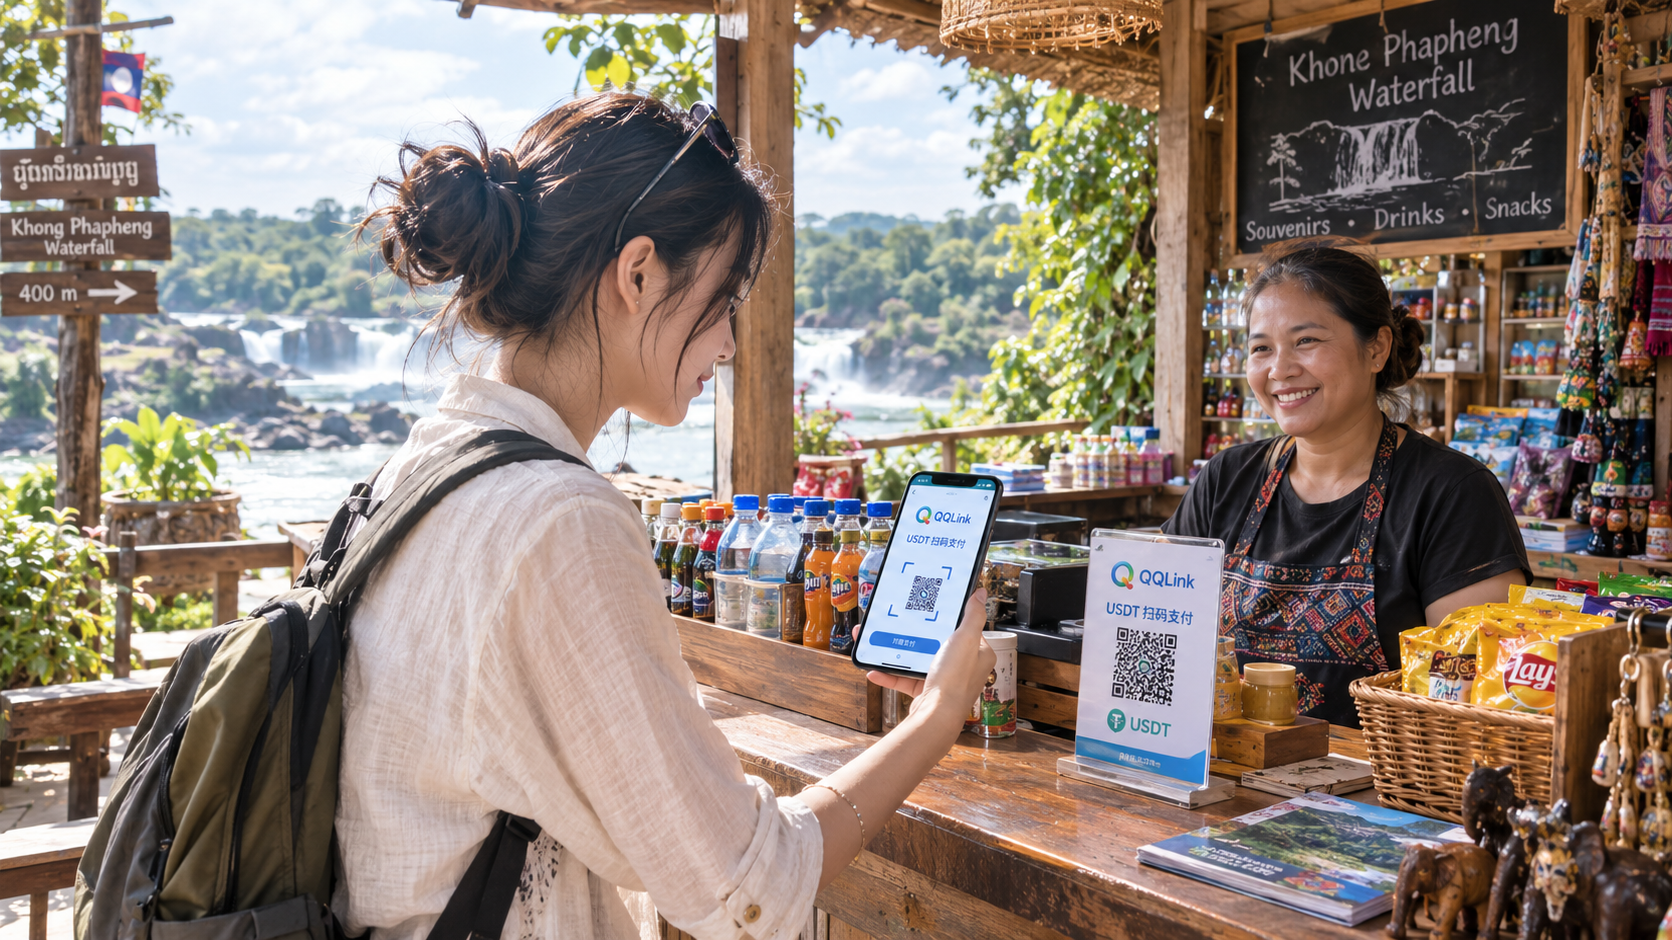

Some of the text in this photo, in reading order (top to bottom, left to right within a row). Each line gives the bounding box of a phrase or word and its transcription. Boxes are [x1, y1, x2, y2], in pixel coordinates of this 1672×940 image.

[1288, 17, 1518, 87] Khone Phapheng
[1349, 58, 1476, 113] Waterfall
[1245, 191, 1552, 242] Souvenirs Drinks Snacks
[11, 216, 152, 239] Khong Phapheng
[44, 239, 115, 255] Waterfall
[19, 284, 78, 302] 400 m
[934, 511, 971, 524] QQLink
[906, 534, 966, 549] USDT 扫码支付
[1139, 569, 1195, 589] QQLink
[1106, 602, 1193, 625] USDT 扫码支付
[1130, 717, 1172, 737] USDT
